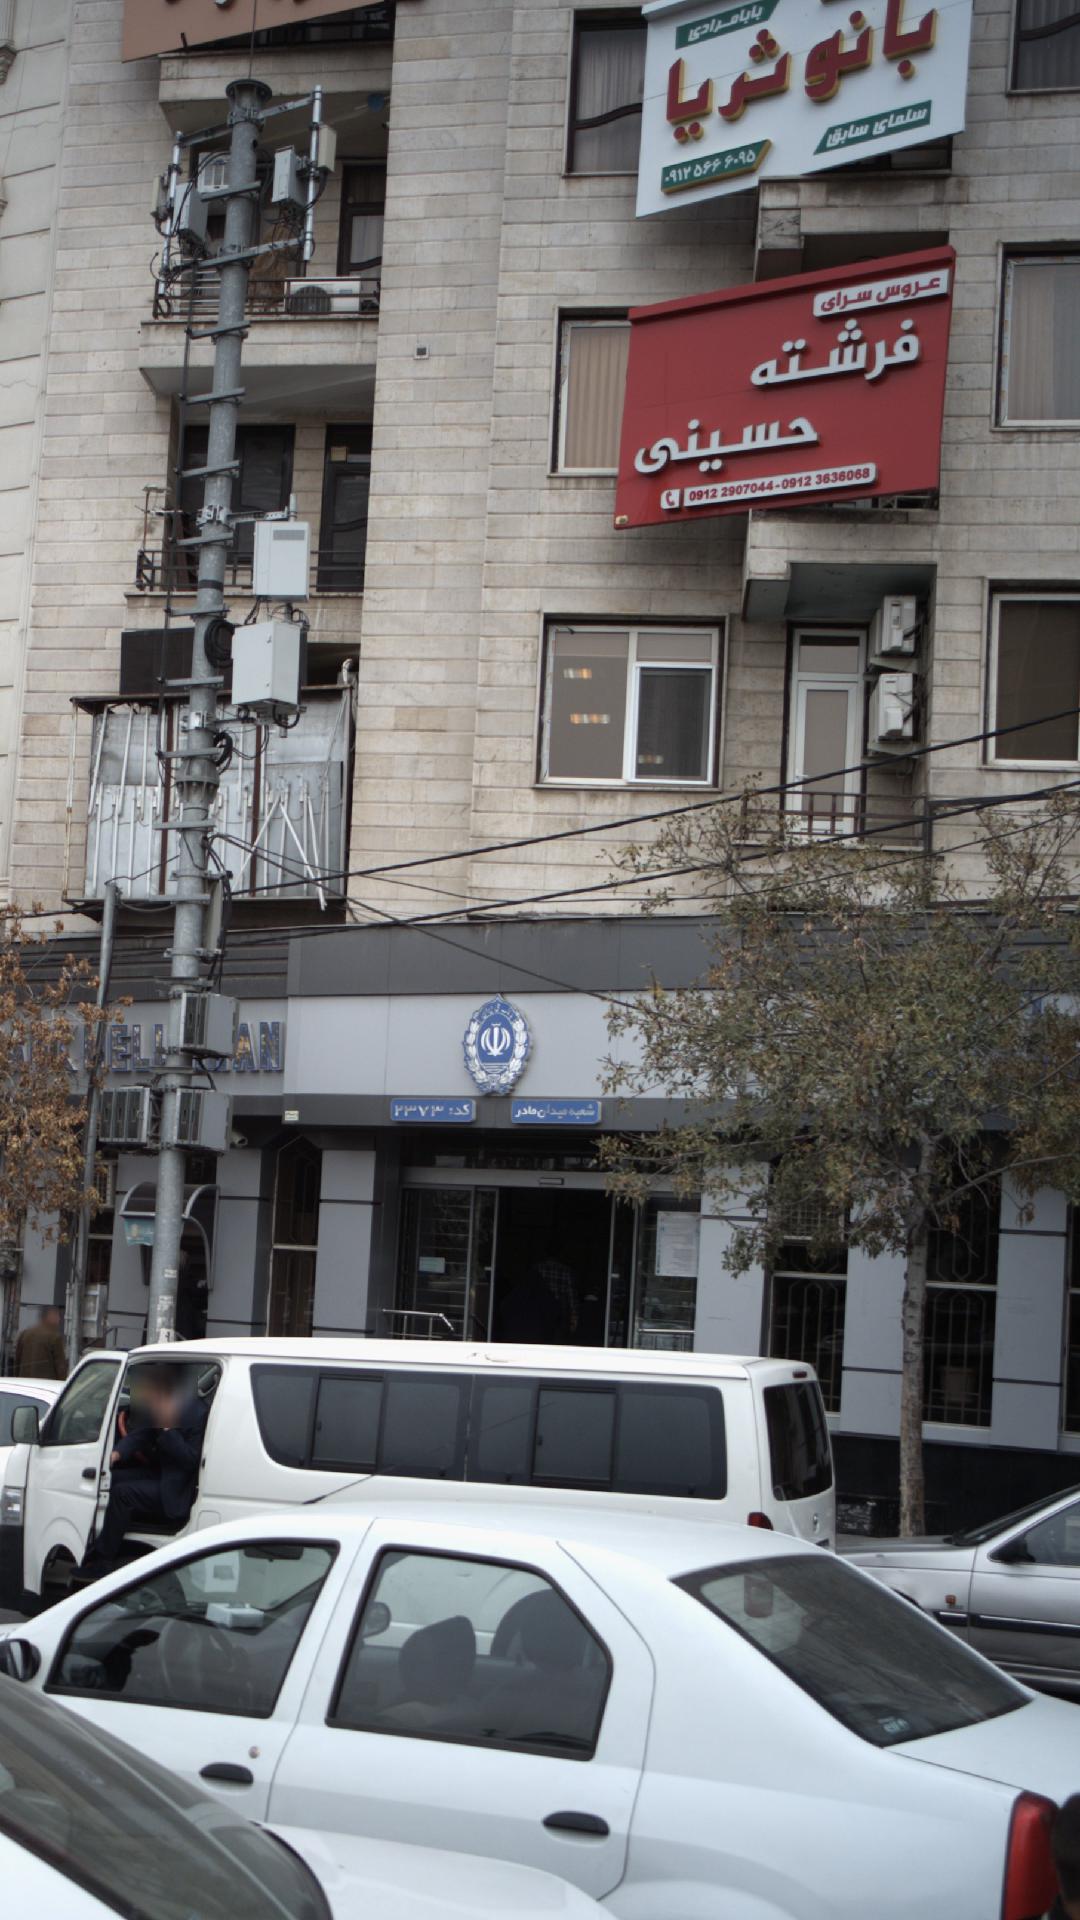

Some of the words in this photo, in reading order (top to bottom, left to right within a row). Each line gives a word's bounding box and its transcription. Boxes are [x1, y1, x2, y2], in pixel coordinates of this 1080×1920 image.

[803, 0, 939, 104] بانو
[666, 29, 792, 144] ثریا
[826, 123, 870, 148] سابق
[820, 289, 872, 312] سرای
[876, 277, 941, 303] عروس
[751, 318, 920, 386] فرشته
[634, 416, 819, 473] حسینی
[689, 488, 718, 501] 0912
